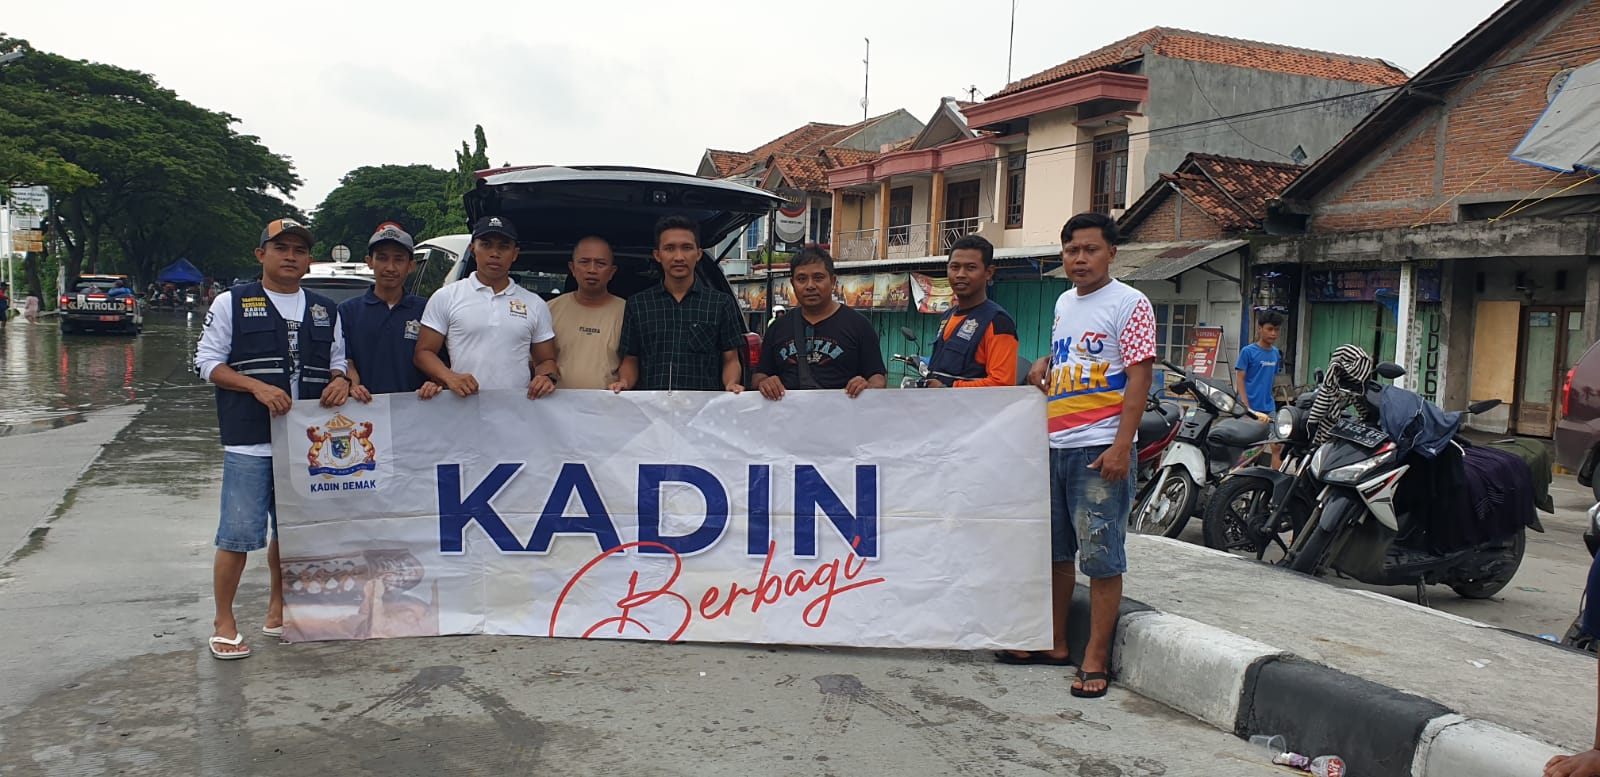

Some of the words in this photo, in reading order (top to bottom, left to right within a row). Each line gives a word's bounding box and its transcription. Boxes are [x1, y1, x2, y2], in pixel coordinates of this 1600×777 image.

[77, 302, 117, 310] PATROLI
[310, 483, 339, 492] KADIN
[343, 480, 376, 490] DEMAK
[436, 462, 877, 558] KADIN
[549, 536, 885, 642] Berbagi
